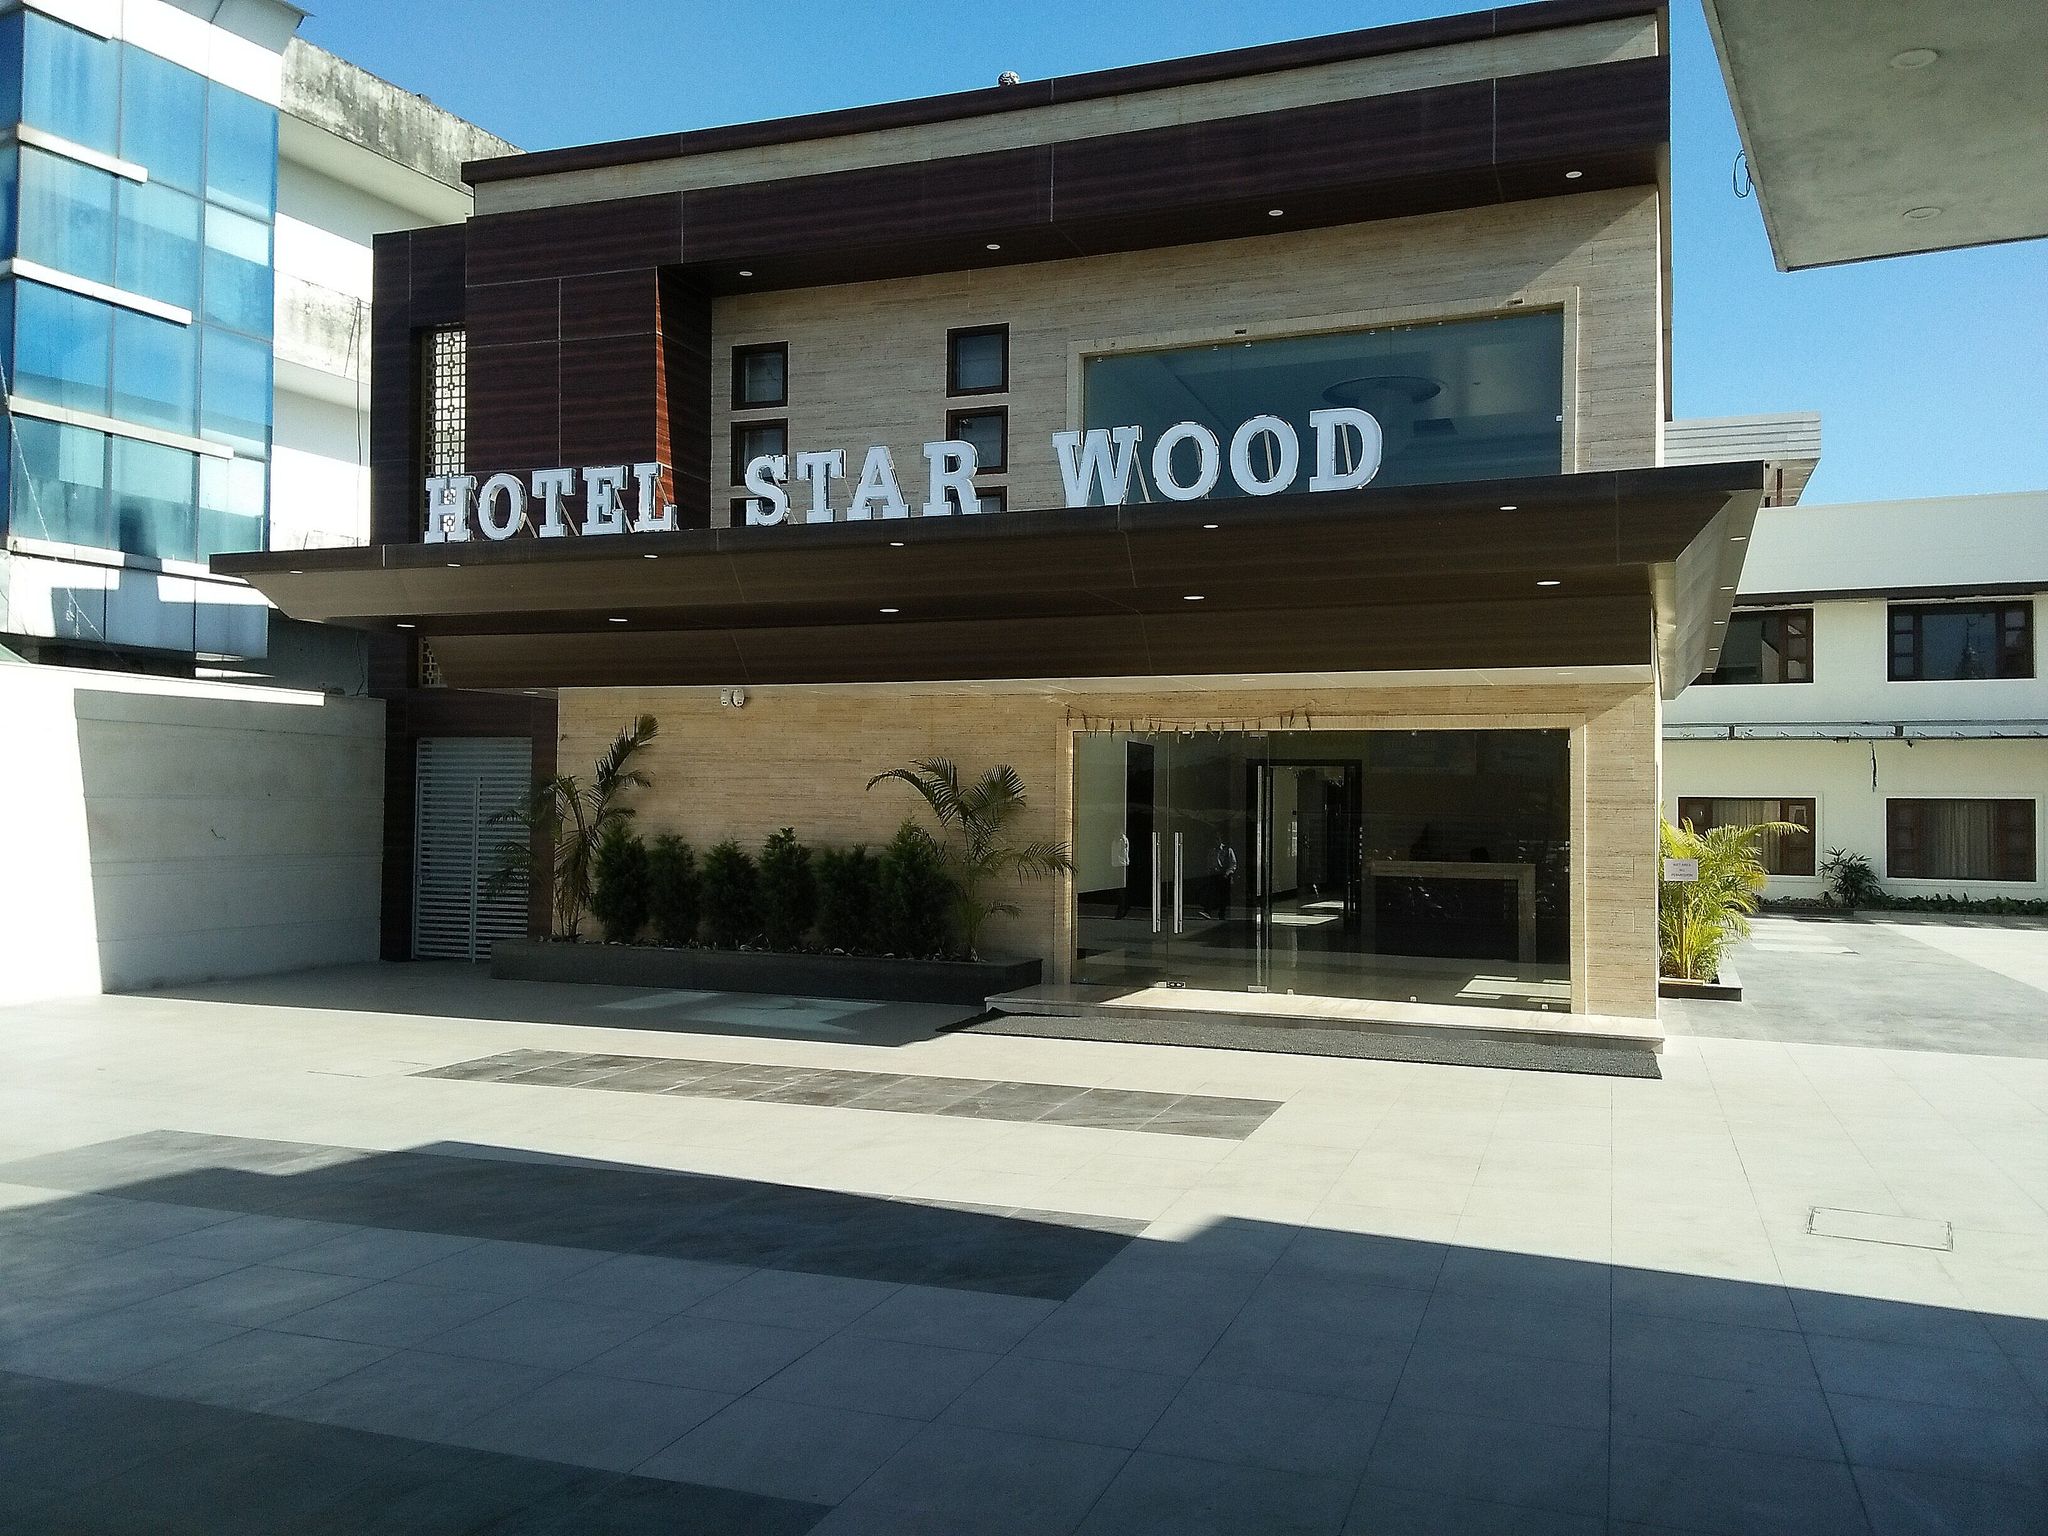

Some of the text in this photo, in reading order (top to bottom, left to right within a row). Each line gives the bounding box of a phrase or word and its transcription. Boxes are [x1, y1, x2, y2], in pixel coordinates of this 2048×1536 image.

[424, 407, 1384, 544] HOTEL STAR WOOD
